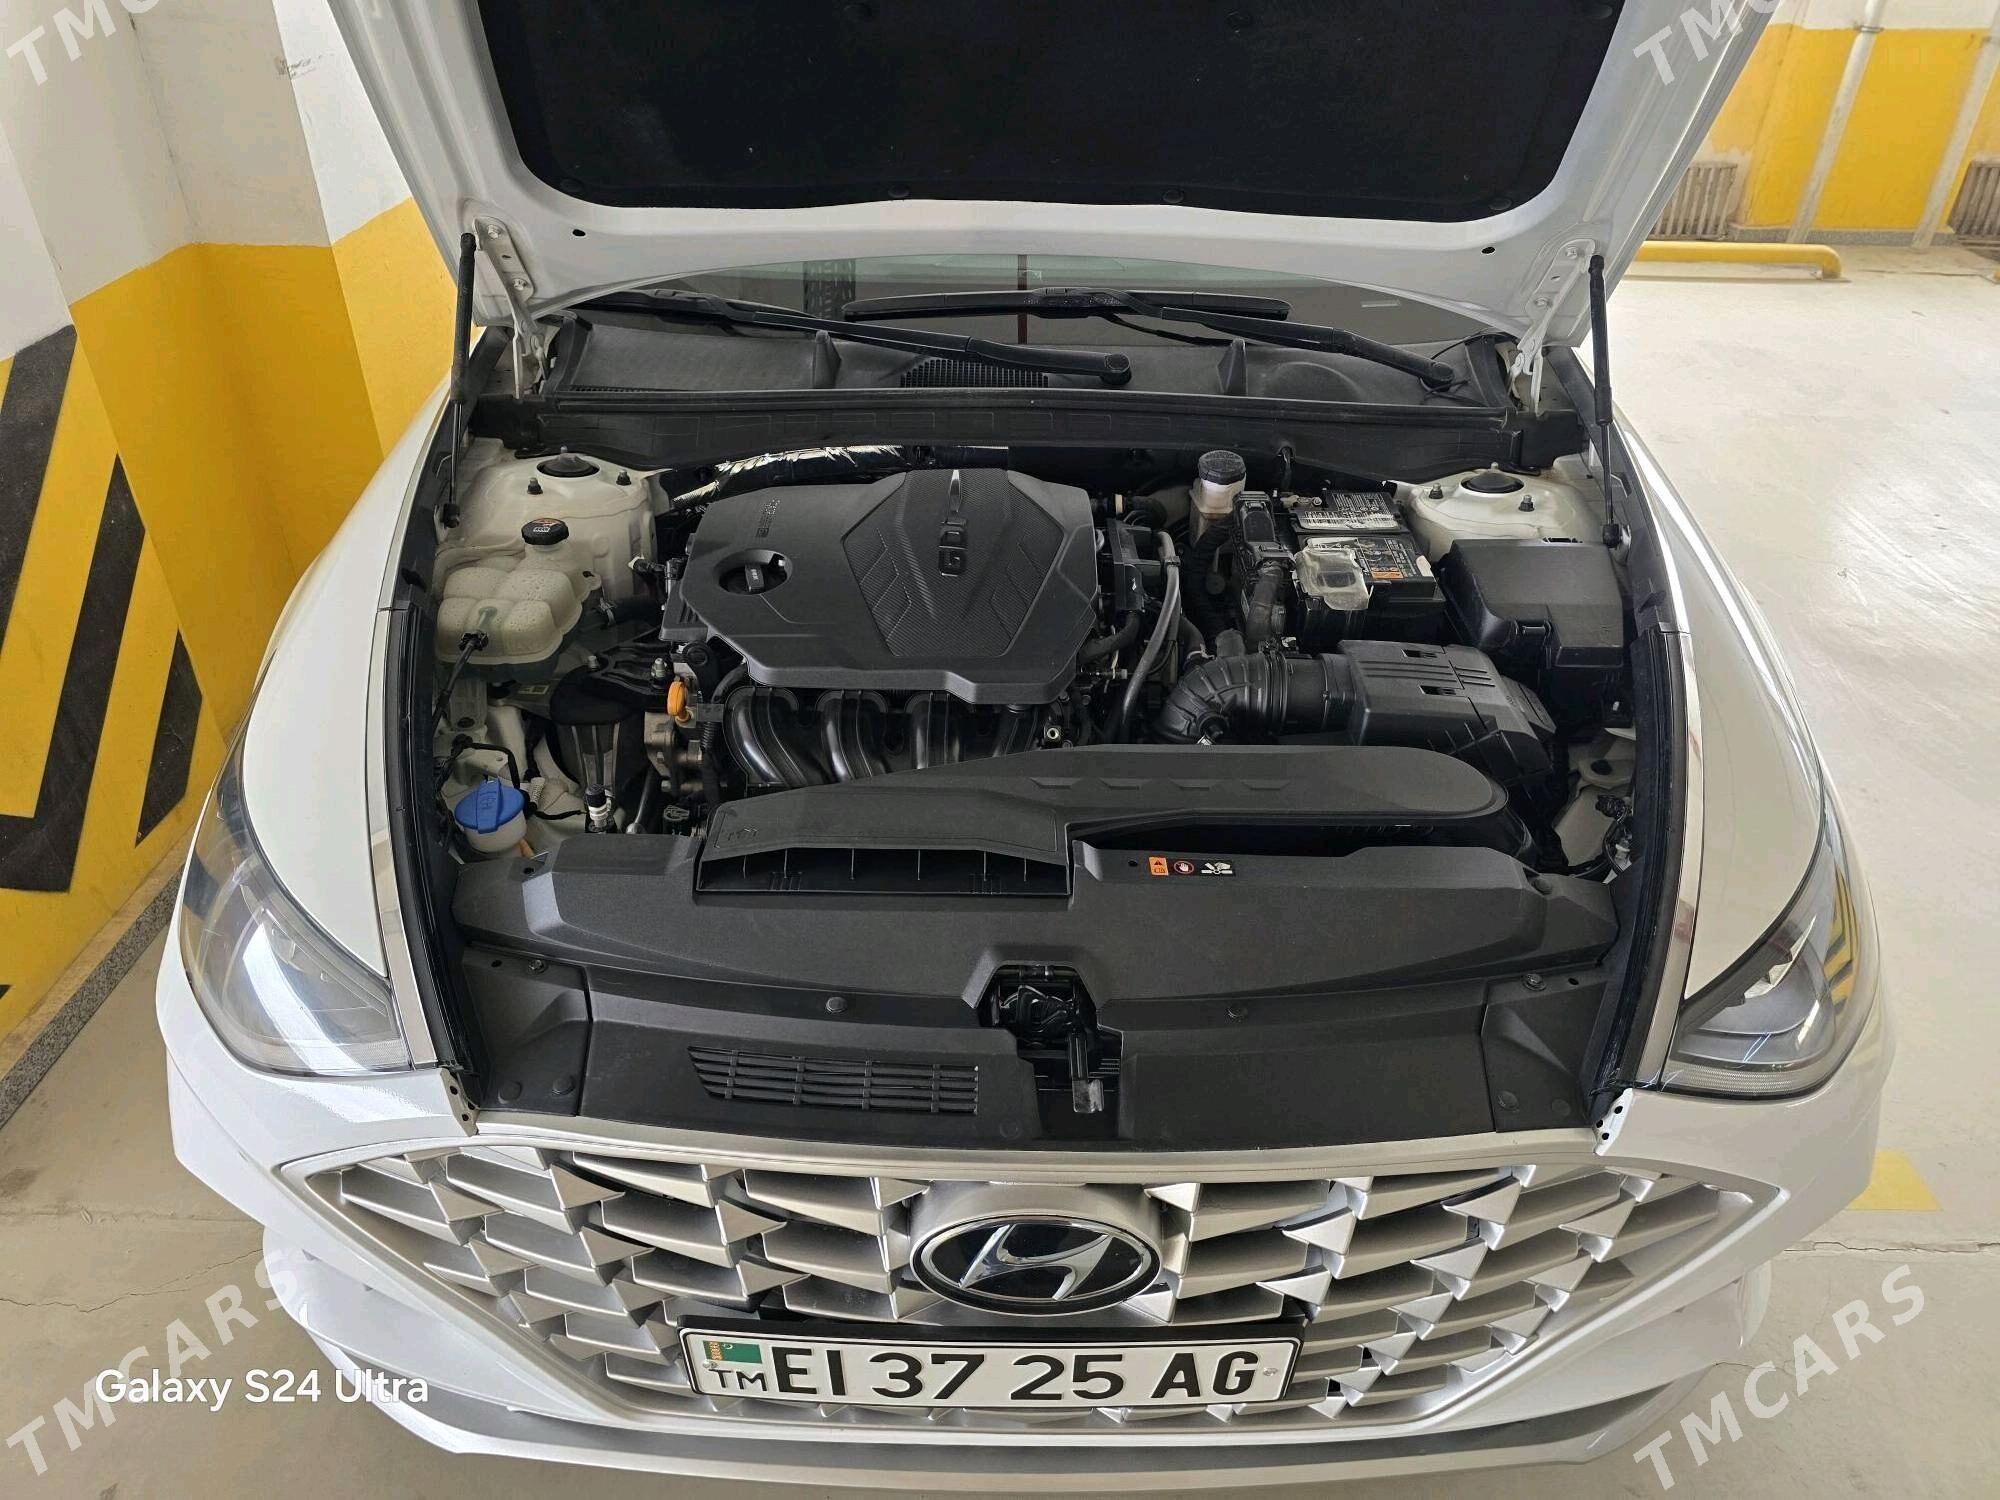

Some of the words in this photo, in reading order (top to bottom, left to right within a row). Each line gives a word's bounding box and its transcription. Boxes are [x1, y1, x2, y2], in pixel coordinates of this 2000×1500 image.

[708, 1368, 768, 1392] TM
[771, 1346, 847, 1395] EI
[869, 1352, 985, 1400] 37
[1010, 1354, 1125, 1401] 25
[1150, 1350, 1259, 1399] AG
